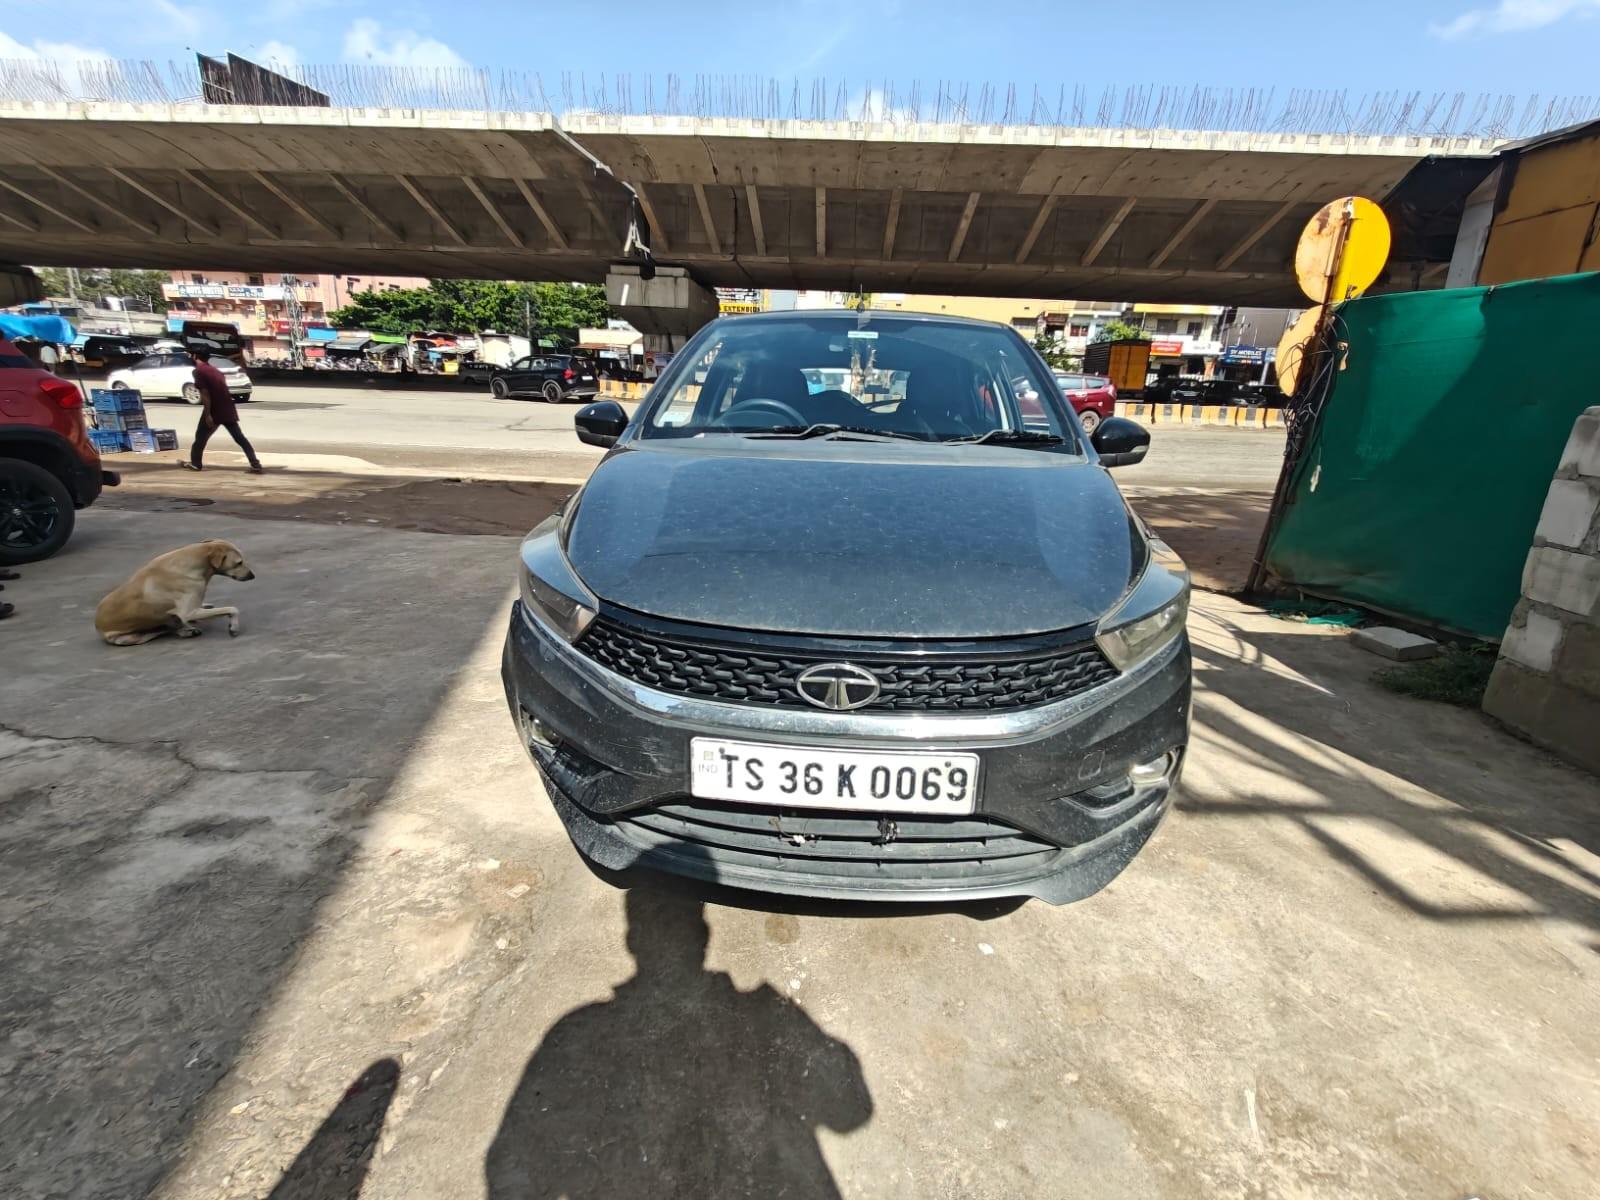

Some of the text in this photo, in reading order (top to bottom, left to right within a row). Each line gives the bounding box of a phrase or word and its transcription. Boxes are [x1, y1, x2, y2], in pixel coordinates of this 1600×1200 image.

[720, 754, 969, 801] TS 36 K 0069
